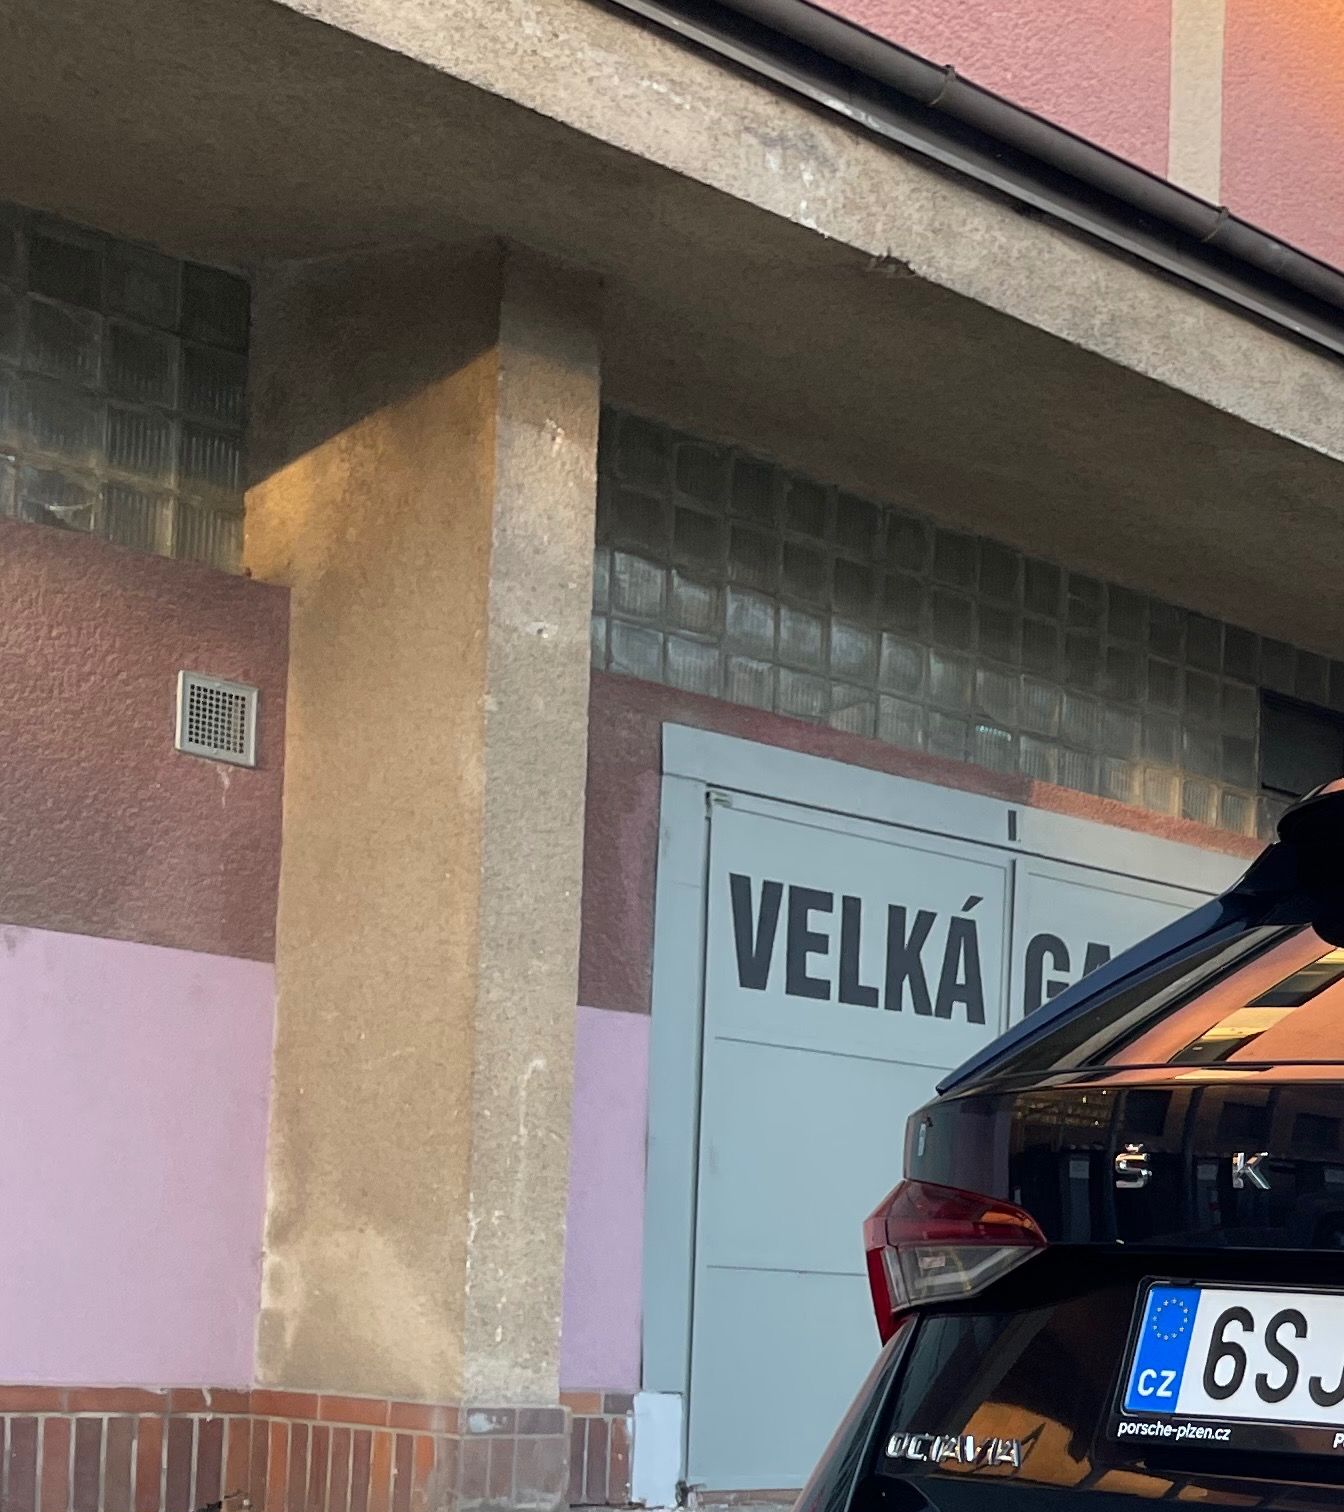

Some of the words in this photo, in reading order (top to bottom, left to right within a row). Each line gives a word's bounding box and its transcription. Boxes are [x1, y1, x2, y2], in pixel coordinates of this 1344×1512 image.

[729, 872, 985, 1025] VELKÁ
[1137, 1369, 1177, 1398] CZ
[1117, 1420, 1231, 1442] porsche-plzen.cz
